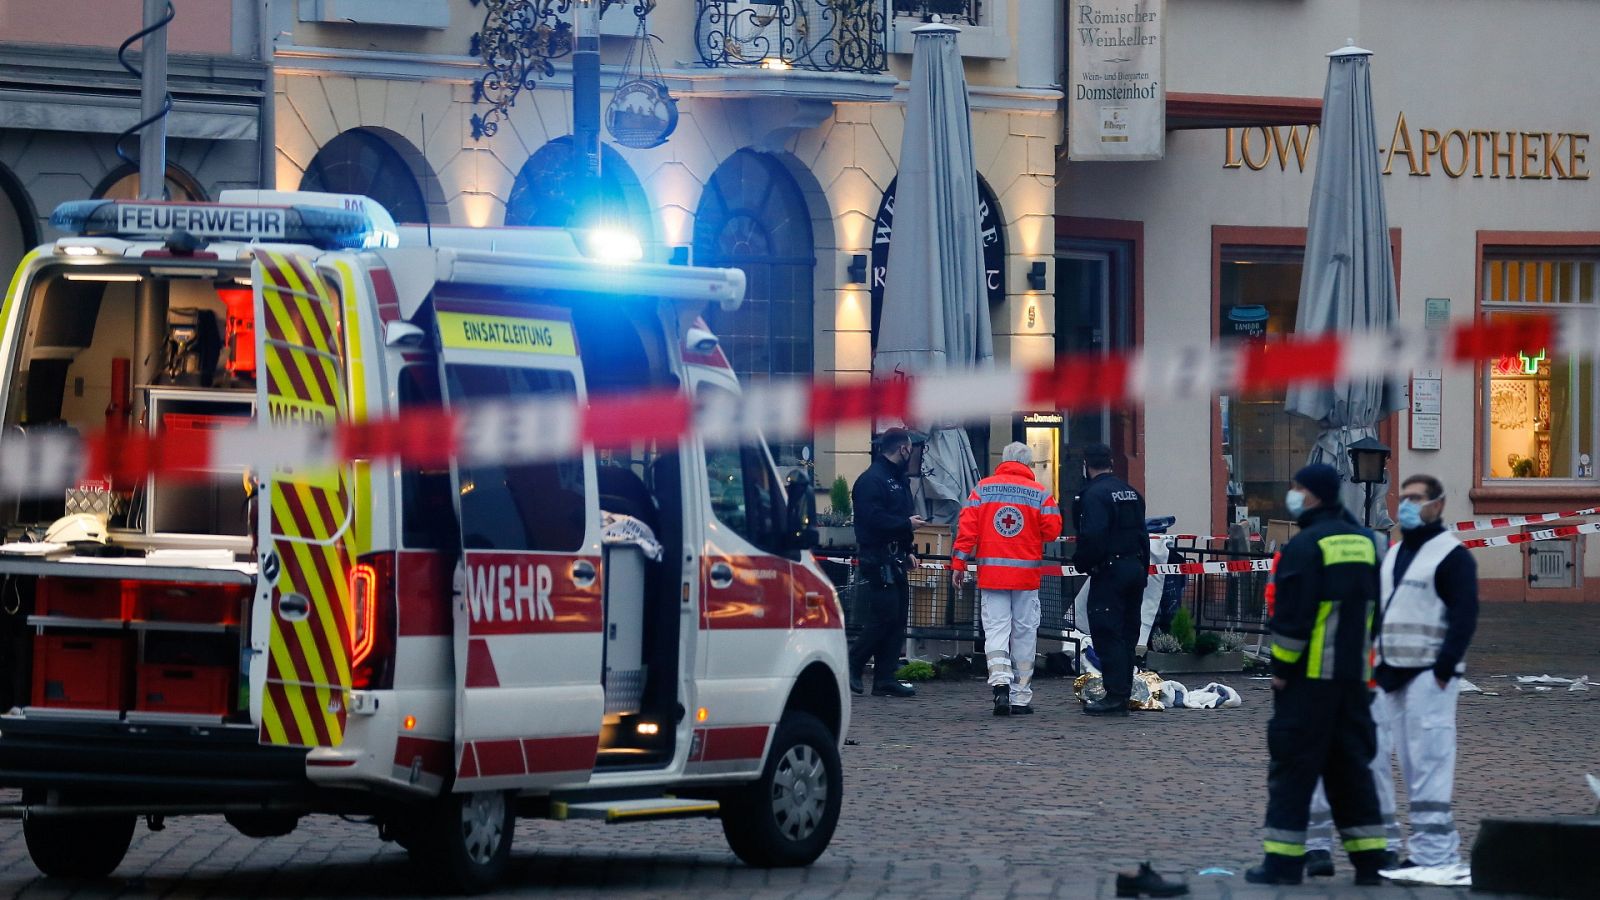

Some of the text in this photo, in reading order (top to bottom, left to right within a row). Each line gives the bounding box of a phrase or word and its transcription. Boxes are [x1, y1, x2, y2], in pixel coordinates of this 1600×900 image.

[1079, 4, 1156, 24] Römischer
[1078, 27, 1156, 47] Weinkeller
[1083, 73, 1149, 82] Wein- und Biergarten
[1077, 82, 1157, 101] Domsteinhof
[122, 207, 281, 233] FEUERWEHR
[463, 321, 552, 347] EINSATZLEITUNG
[1034, 413, 1063, 423] Domstein
[982, 486, 1040, 499] RETTUNGSDIENST
[1220, 560, 1269, 572] POLIZEI
[466, 563, 554, 623] WEHR
